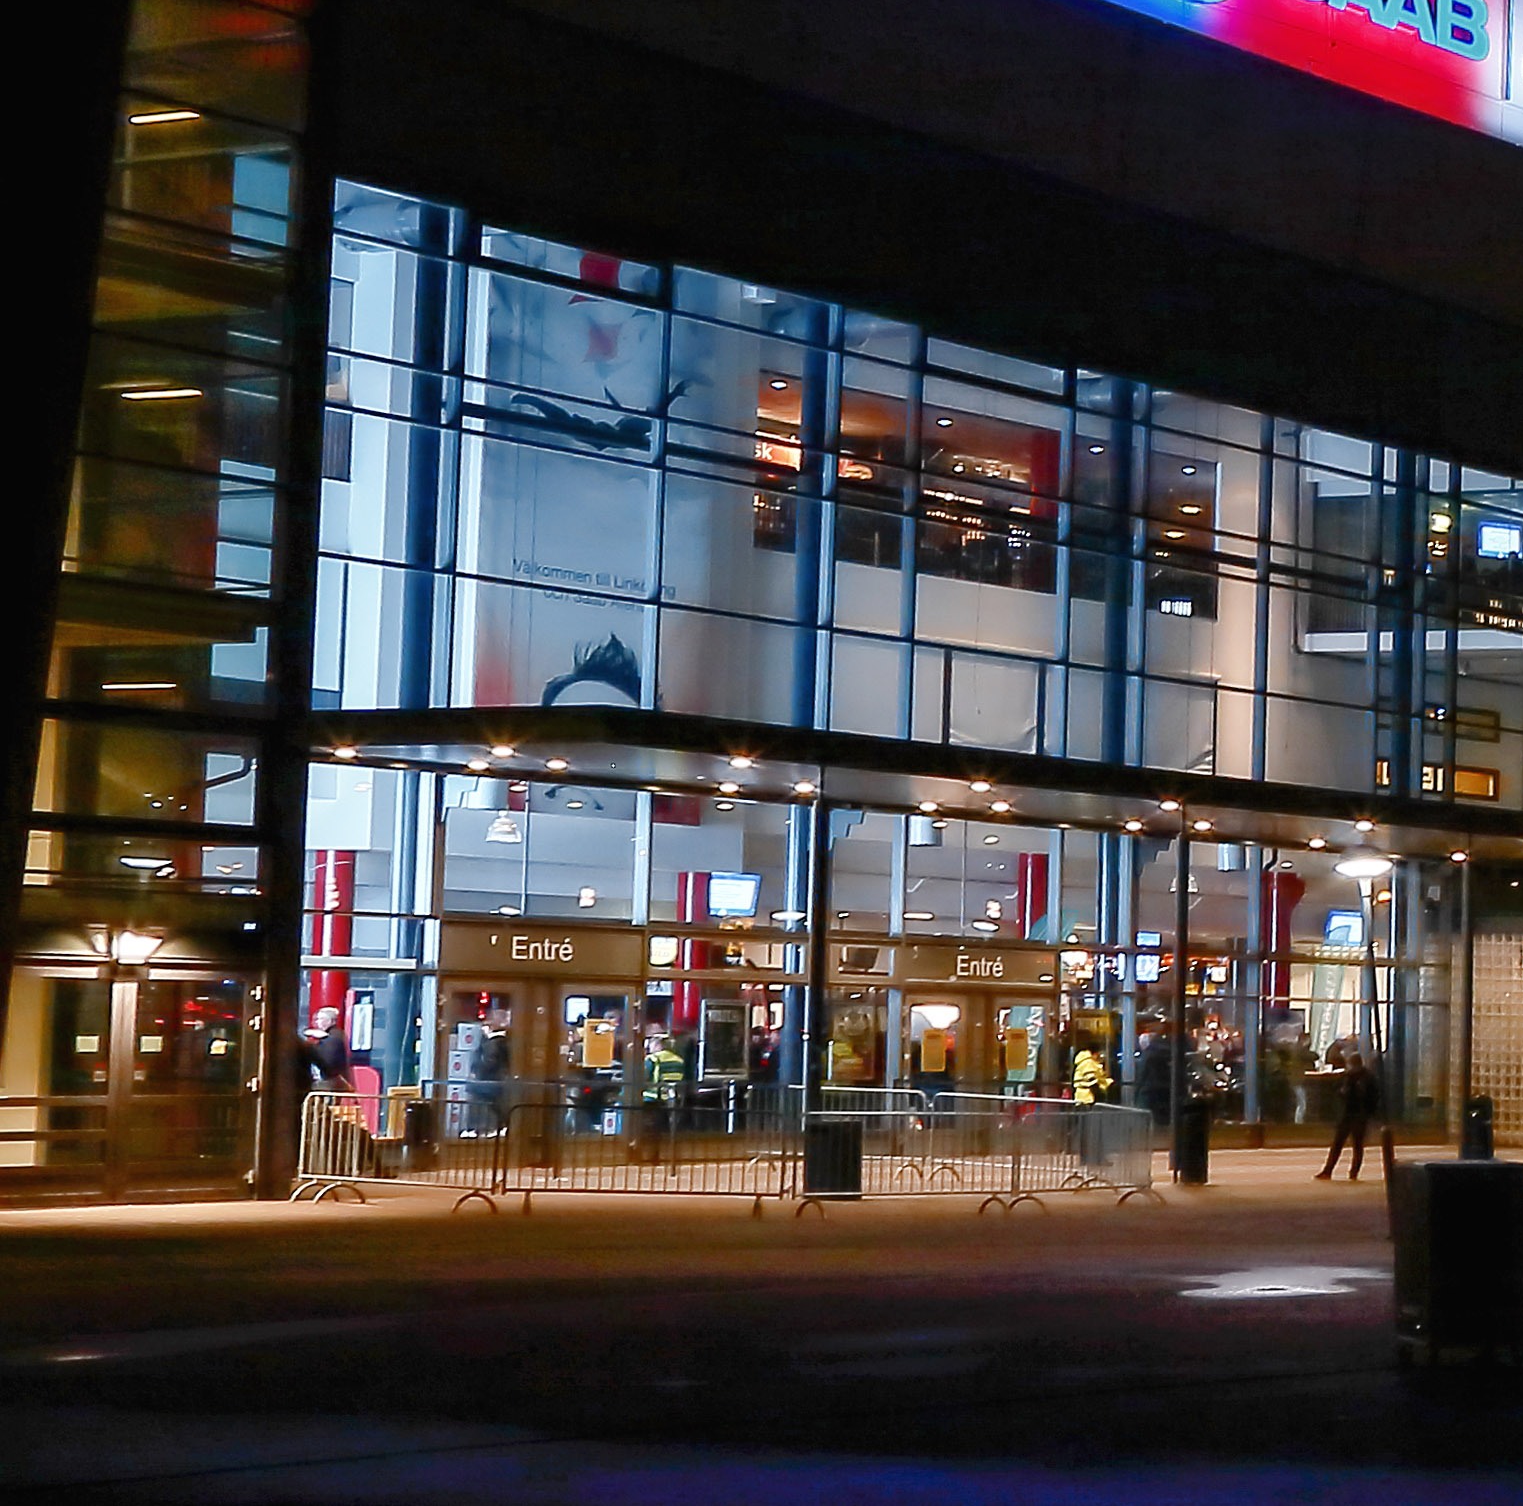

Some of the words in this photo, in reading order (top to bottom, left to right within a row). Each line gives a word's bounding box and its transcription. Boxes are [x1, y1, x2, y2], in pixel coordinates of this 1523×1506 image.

[613, 574, 676, 600] Linkng
[511, 935, 574, 962] Entré
[957, 955, 1003, 978] Entré
